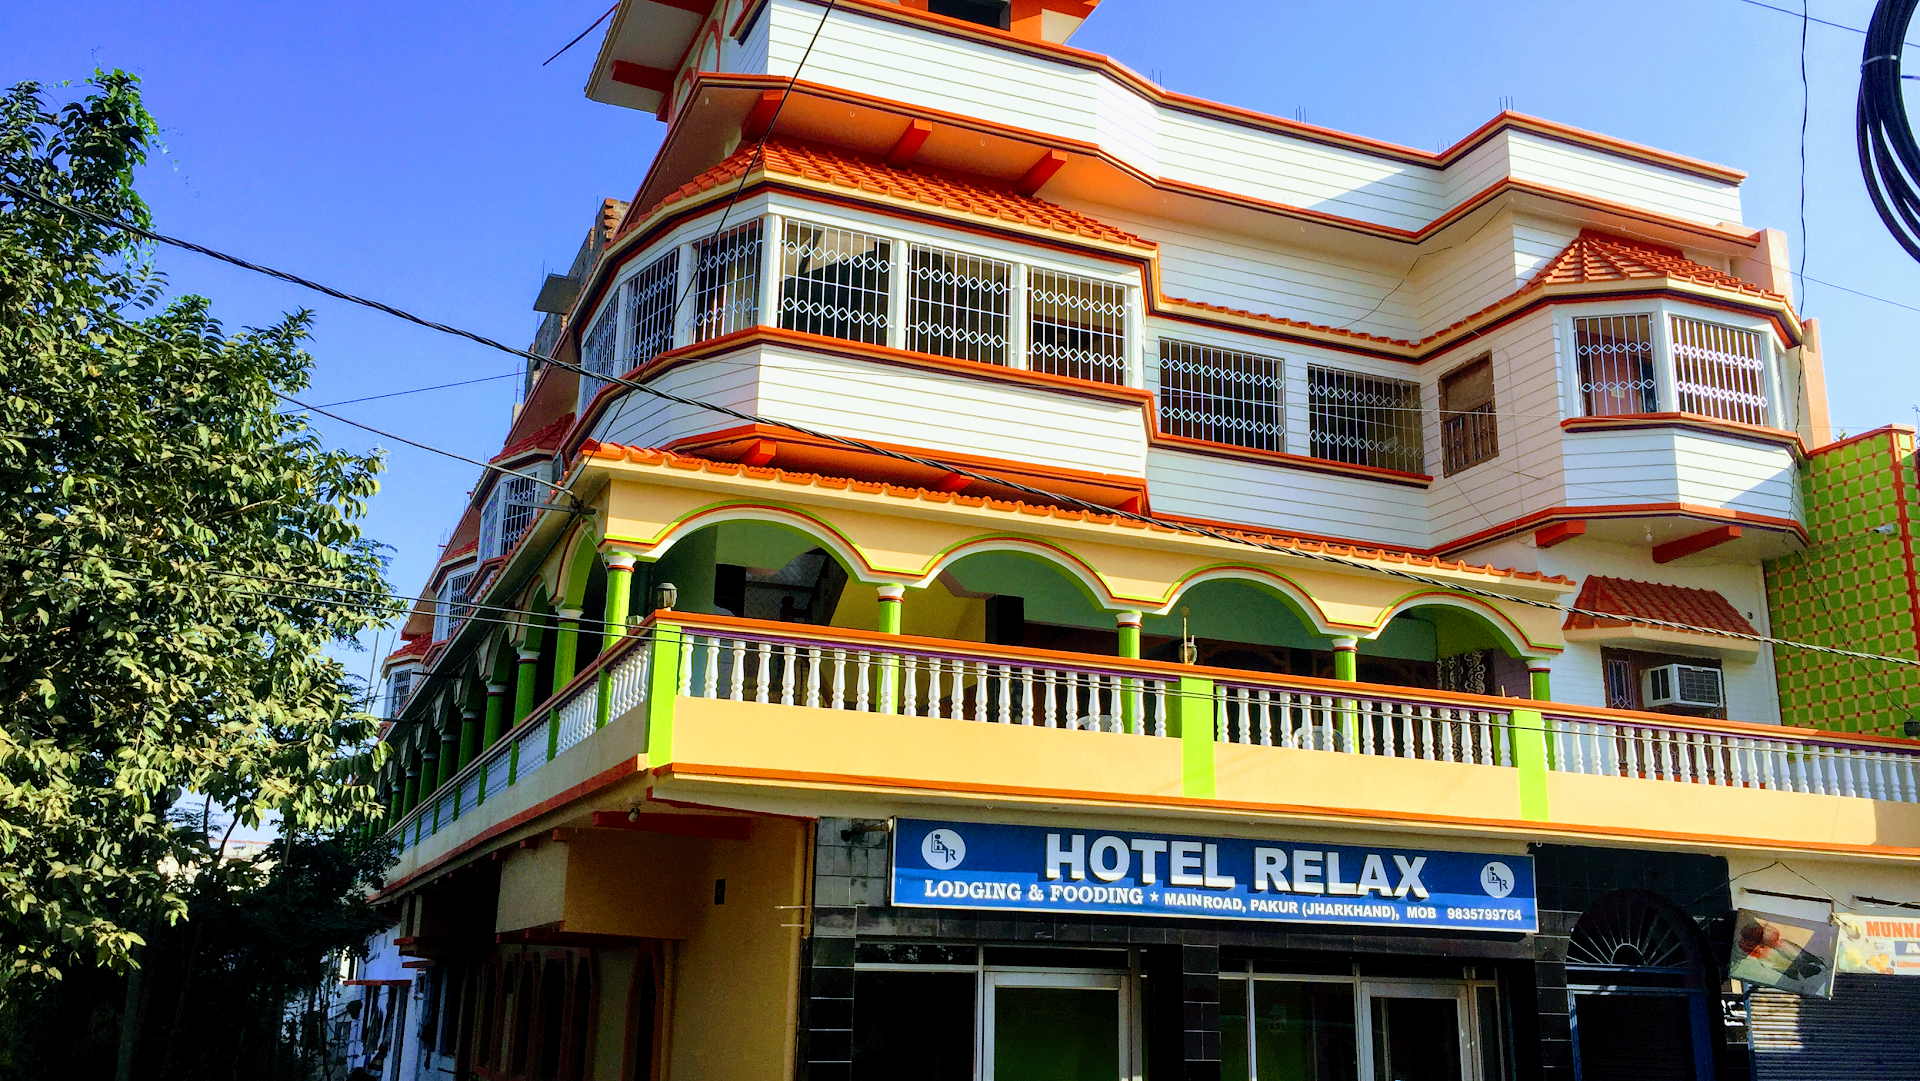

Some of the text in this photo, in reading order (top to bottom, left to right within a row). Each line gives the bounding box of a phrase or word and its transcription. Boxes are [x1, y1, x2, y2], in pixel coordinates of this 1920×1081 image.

[1046, 833, 1430, 899] HOTEL RELAX
[925, 879, 1021, 900] LODGING
[1029, 884, 1044, 900] &
[1050, 885, 1143, 905] FOODING
[1250, 899, 1299, 914] PAKUR
[1302, 901, 1400, 921] (JHARKHAND),
[1406, 906, 1436, 918] MOB
[1447, 908, 1522, 921] 9835799764
